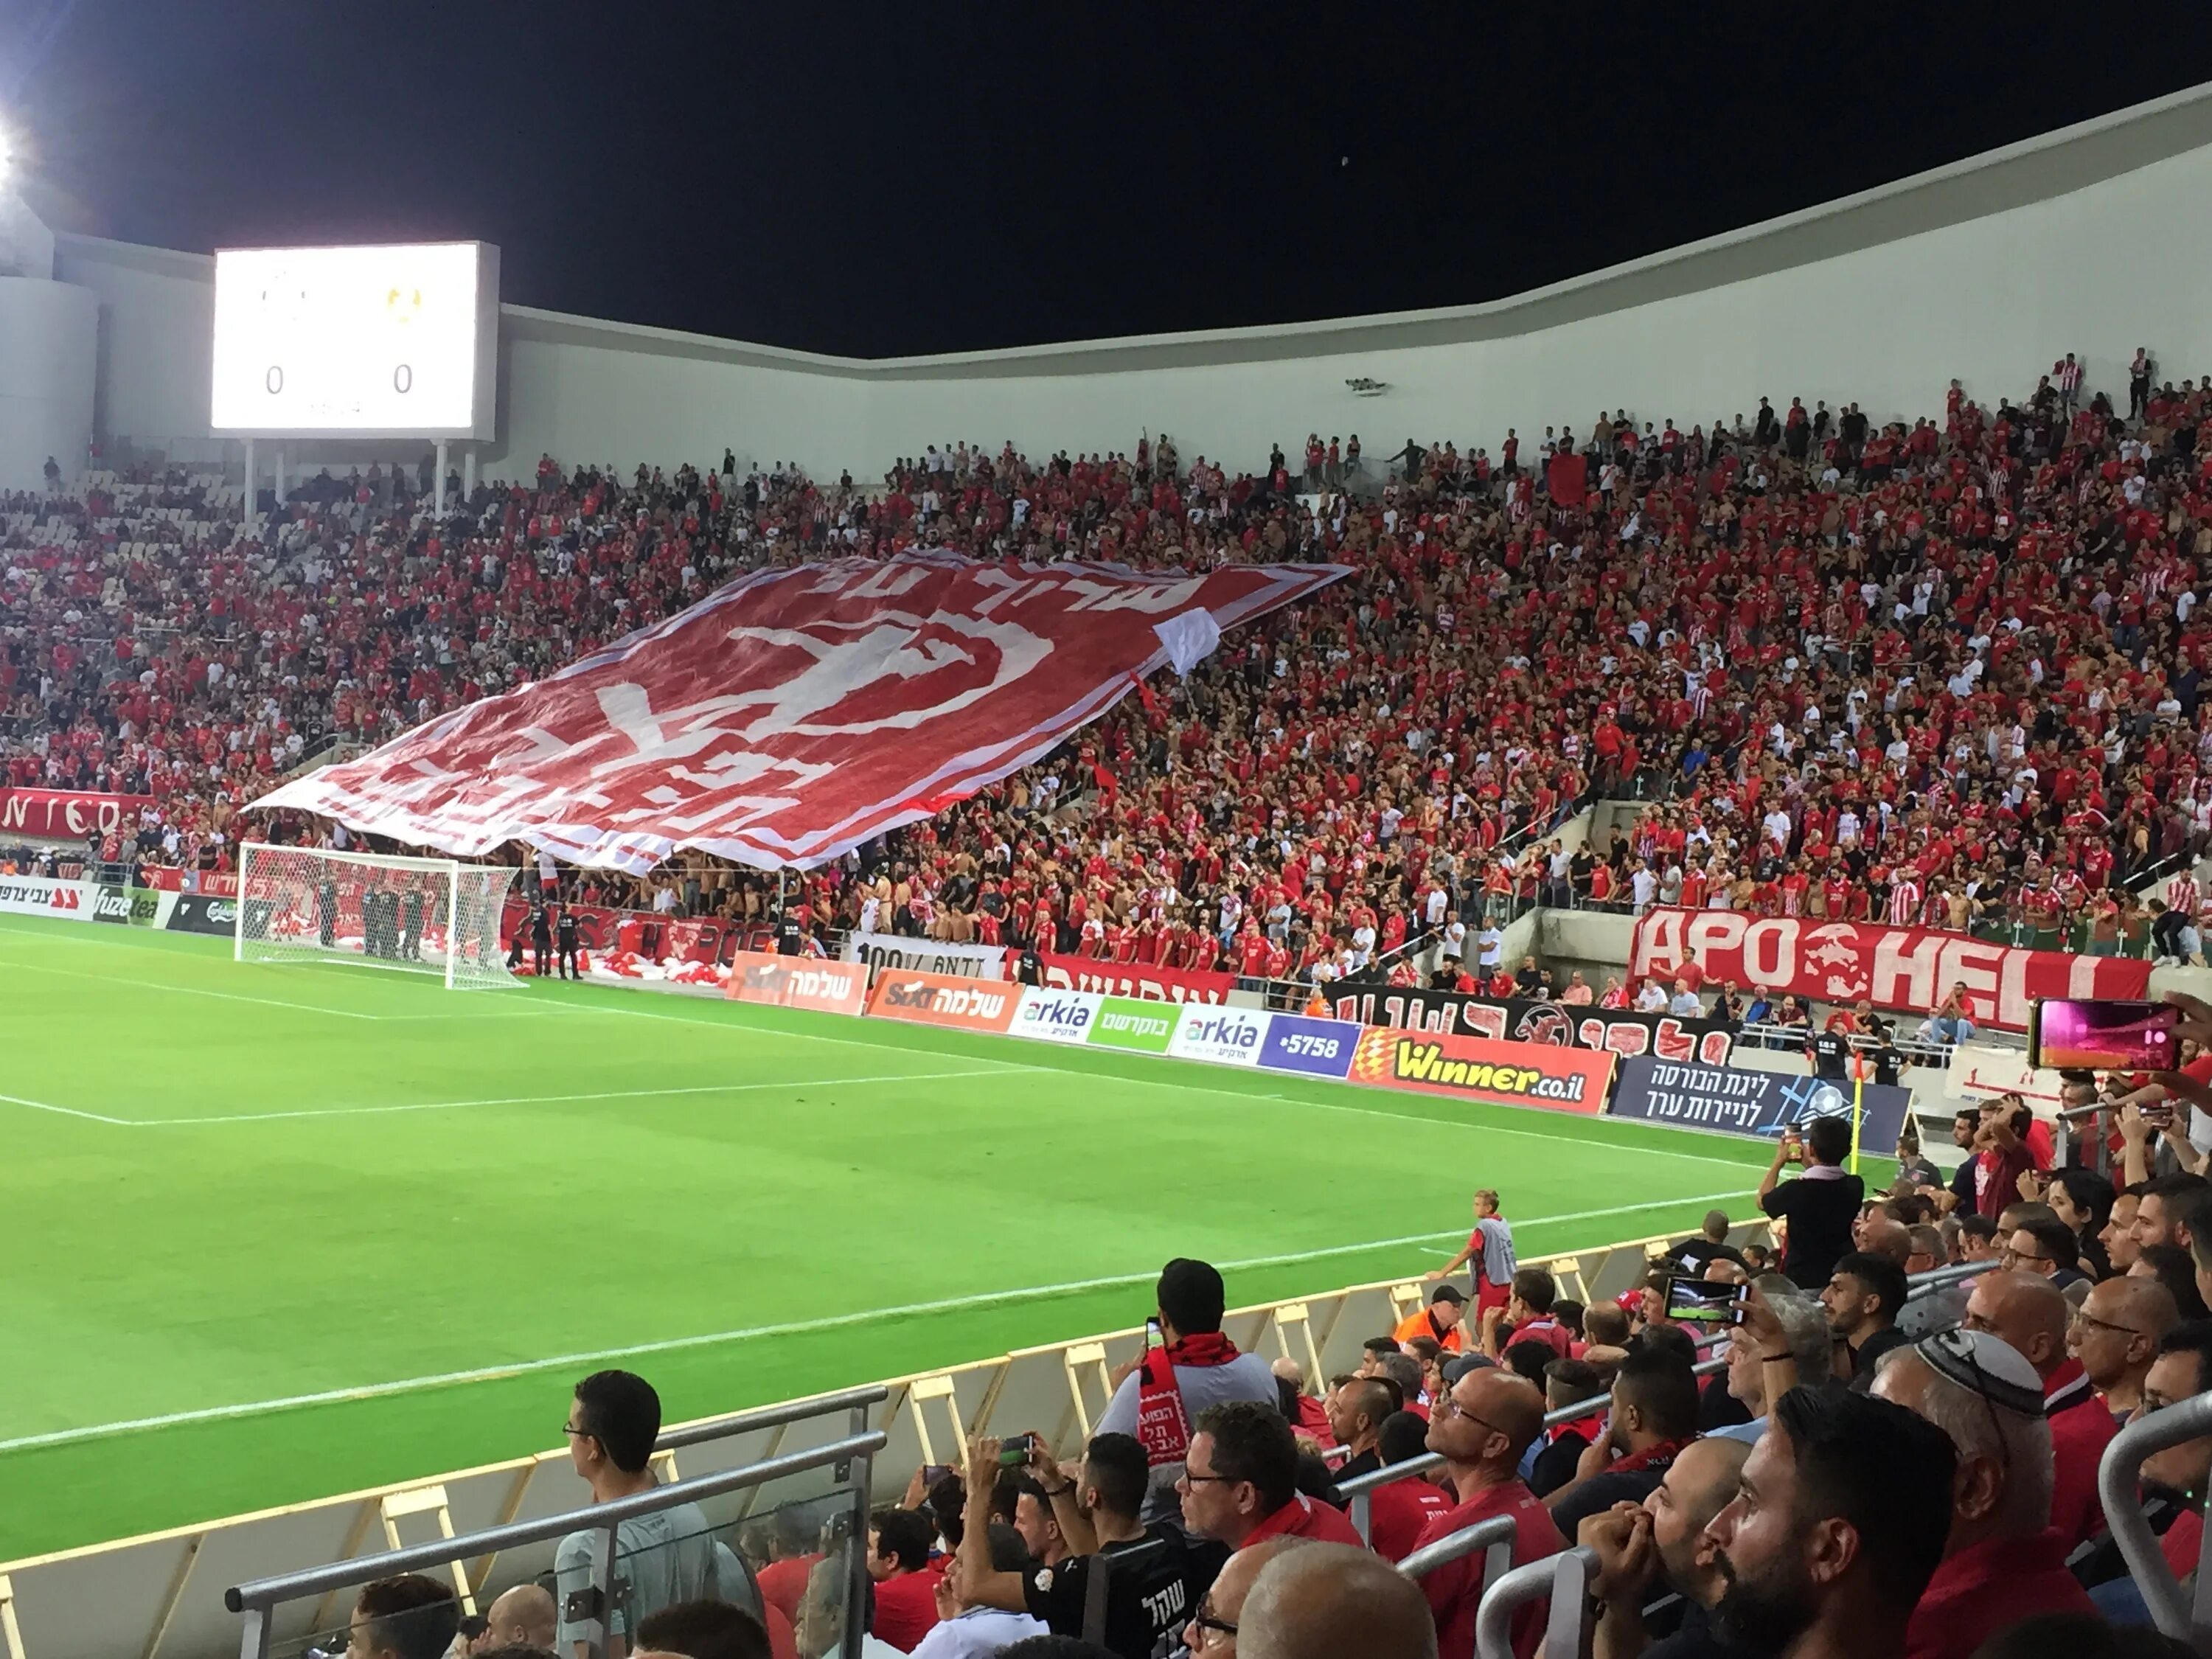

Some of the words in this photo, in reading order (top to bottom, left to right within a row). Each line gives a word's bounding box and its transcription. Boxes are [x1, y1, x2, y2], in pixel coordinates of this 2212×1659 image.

[266, 366, 283, 394] 0
[394, 364, 412, 394] 0
[0, 885, 28, 902] צרפ
[1634, 910, 1800, 987] APO
[787, 970, 852, 1000] שלמה
[933, 987, 1005, 1019] שלמה
[1024, 998, 1090, 1026] arkia
[1185, 1015, 1258, 1047] arkia
[1397, 1040, 1585, 1100] Winner.co.il
[1651, 1065, 1722, 1093] הבורסה
[1722, 1074, 1770, 1099] ליגת
[1646, 1091, 1684, 1116] ערך
[1683, 1096, 1762, 1127] לניירות
[1139, 1408, 1173, 1425] הפוע
[1144, 1425, 1167, 1439] תל
[1151, 1436, 1180, 1450] אבי
[1141, 1579, 1185, 1628] שקל
